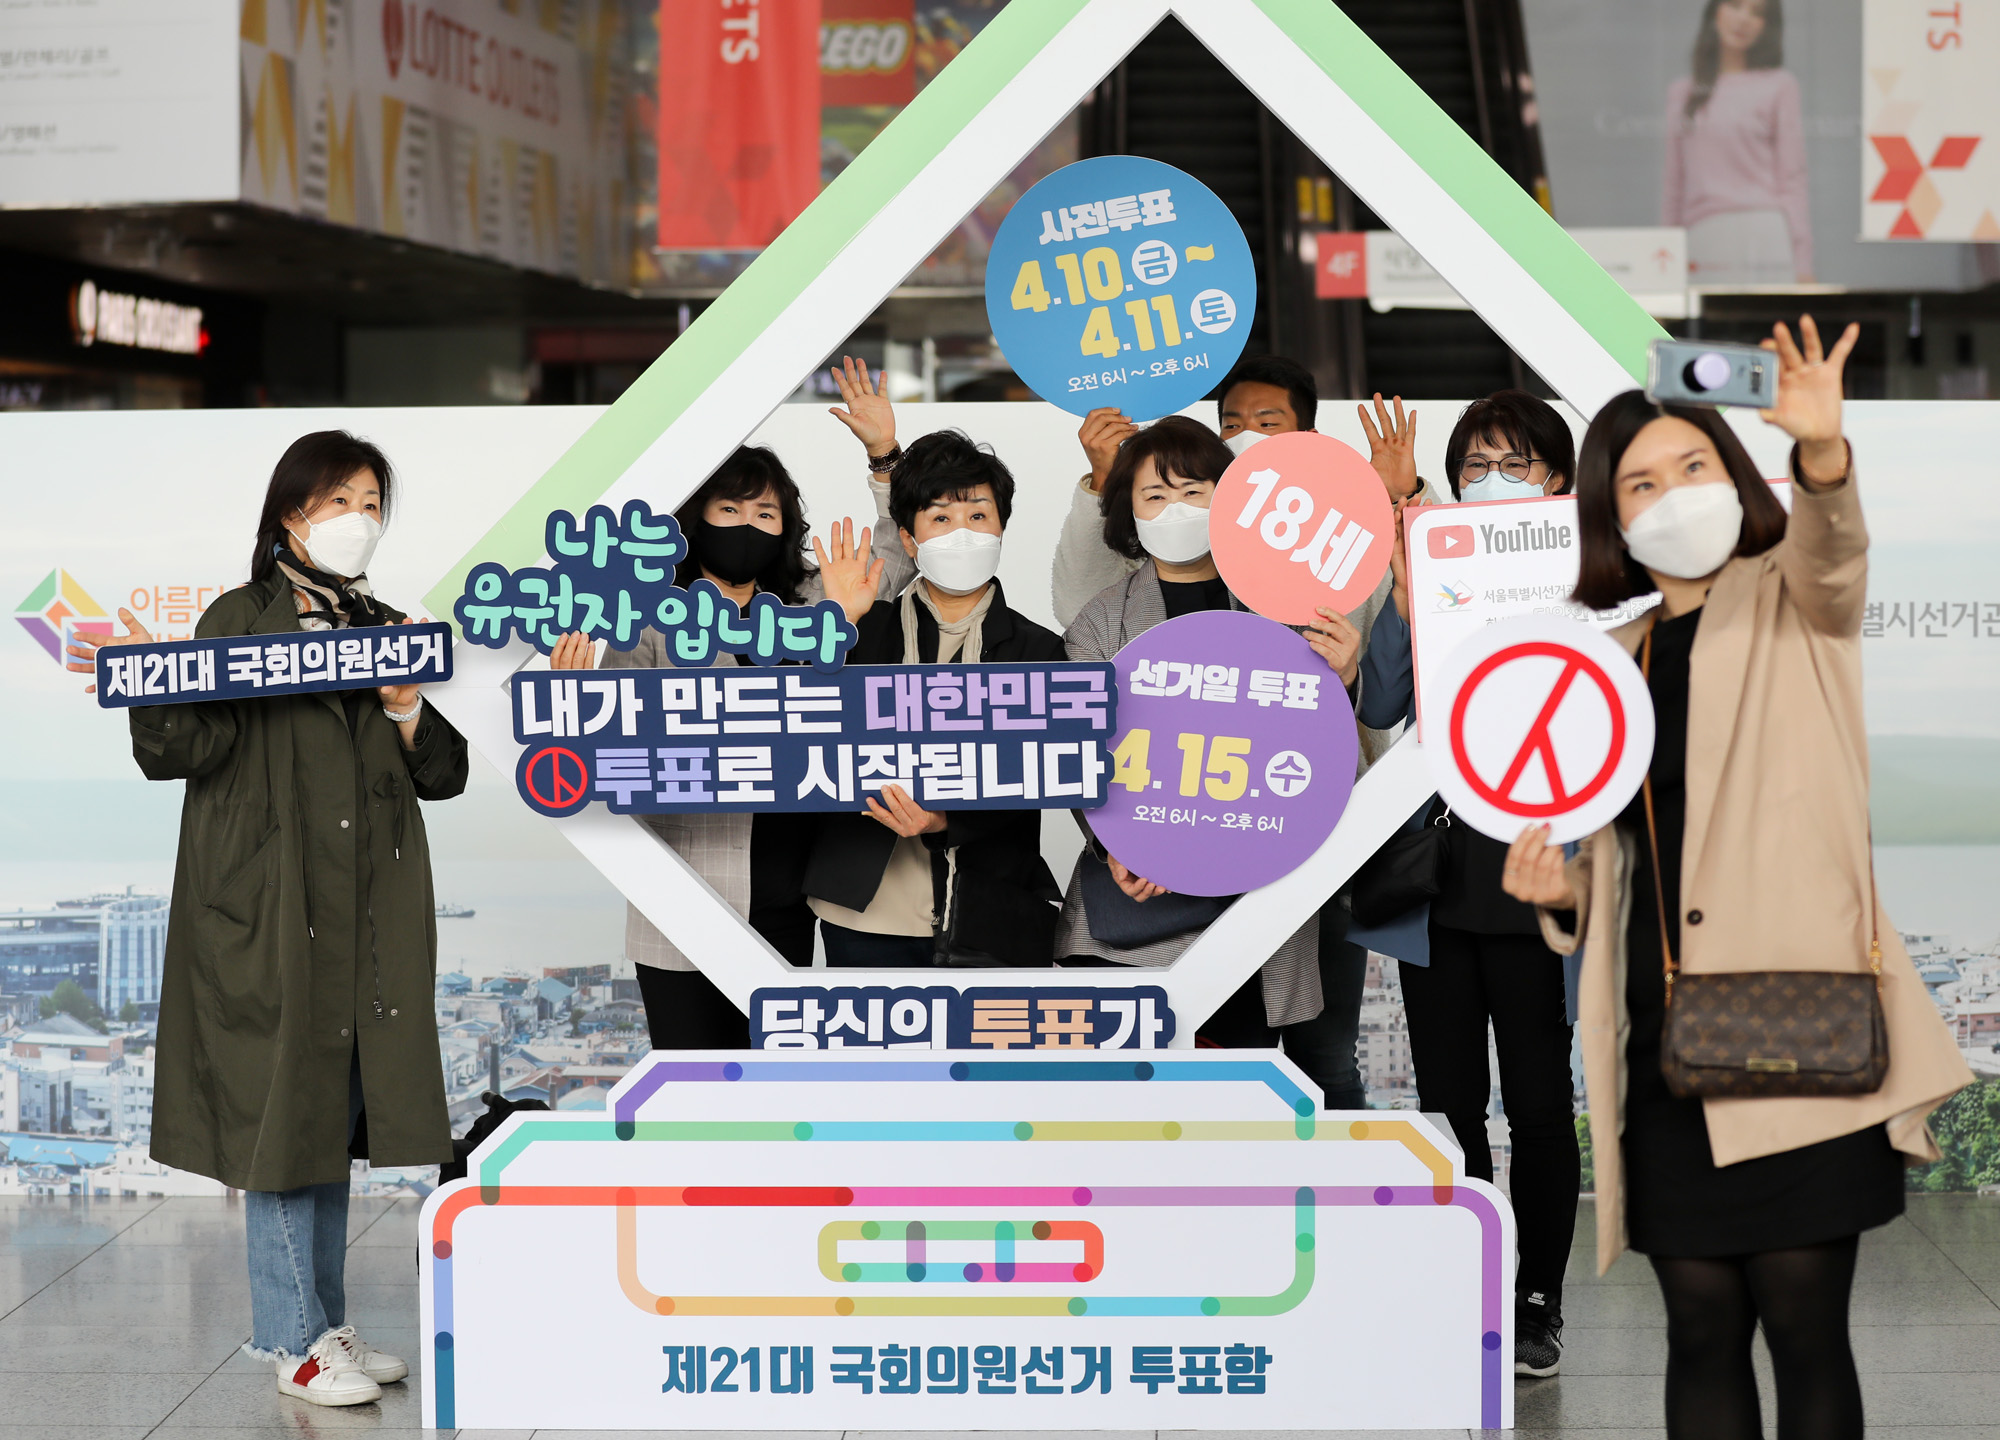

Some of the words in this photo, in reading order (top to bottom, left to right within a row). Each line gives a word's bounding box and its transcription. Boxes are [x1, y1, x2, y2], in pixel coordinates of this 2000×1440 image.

[408, 3, 480, 94] LOTTE
[1039, 189, 1177, 245] 사전투표
[1067, 374, 1098, 393] 오전
[1101, 368, 1128, 387] 6시
[1149, 358, 1181, 378] 오후
[1183, 353, 1209, 373] 6시
[555, 510, 677, 582] 나는
[1236, 468, 1375, 591] 18세
[1479, 519, 1572, 554] YouTube
[463, 573, 642, 648] 유권자
[657, 590, 847, 664] 입니다
[106, 649, 217, 698] 제21대
[227, 632, 445, 688] 국회의원선거
[1130, 659, 1240, 704] 선거일
[1247, 669, 1321, 710] 투표
[520, 677, 644, 737] 내가
[661, 675, 843, 735] 만드는
[865, 671, 1109, 732] 대한민국
[594, 746, 775, 805] 투표로
[797, 740, 1105, 802] 시작됩니다
[1132, 804, 1166, 824] 오전
[1169, 808, 1197, 826] 6시
[1220, 812, 1253, 831] 오후
[1257, 815, 1285, 834] 6시
[762, 998, 948, 1049] 당신의
[970, 998, 1163, 1049] 투표가
[662, 1345, 814, 1395] 제21대
[830, 1343, 1113, 1395] 국회의원선거
[1129, 1342, 1274, 1395] 투표함
